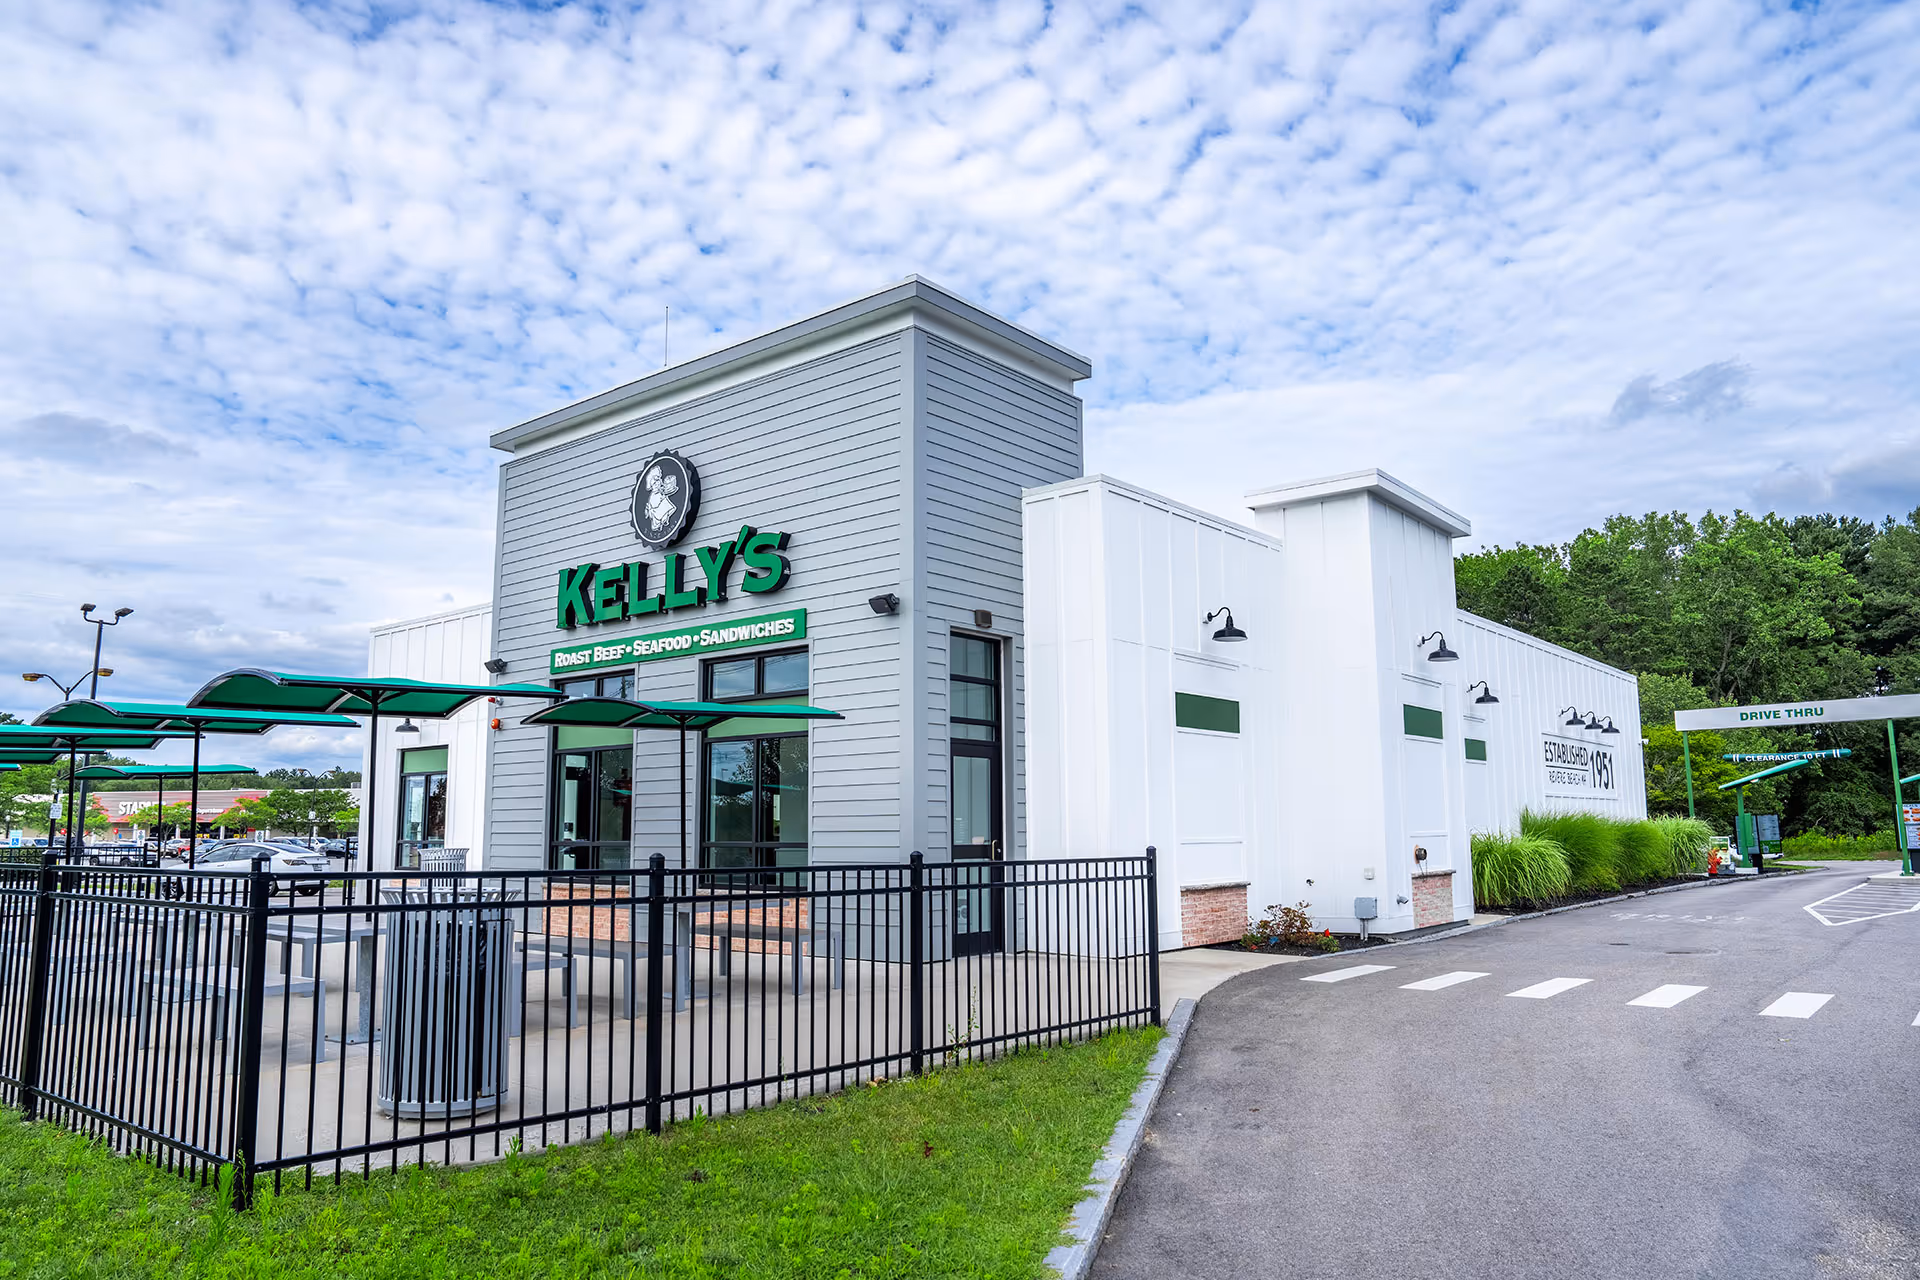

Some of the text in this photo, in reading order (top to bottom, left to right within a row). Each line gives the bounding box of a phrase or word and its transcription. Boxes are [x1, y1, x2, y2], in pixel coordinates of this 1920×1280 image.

[557, 524, 790, 629] KELLY'S
[554, 618, 795, 668] ROAST BEEF SEAFOOD SANDWICHES
[1739, 707, 1824, 721] DRIVE THRU
[1544, 741, 1588, 766] ESTABLISHED
[1590, 750, 1614, 789] 1951
[1745, 754, 1800, 762] CLEARANCE
